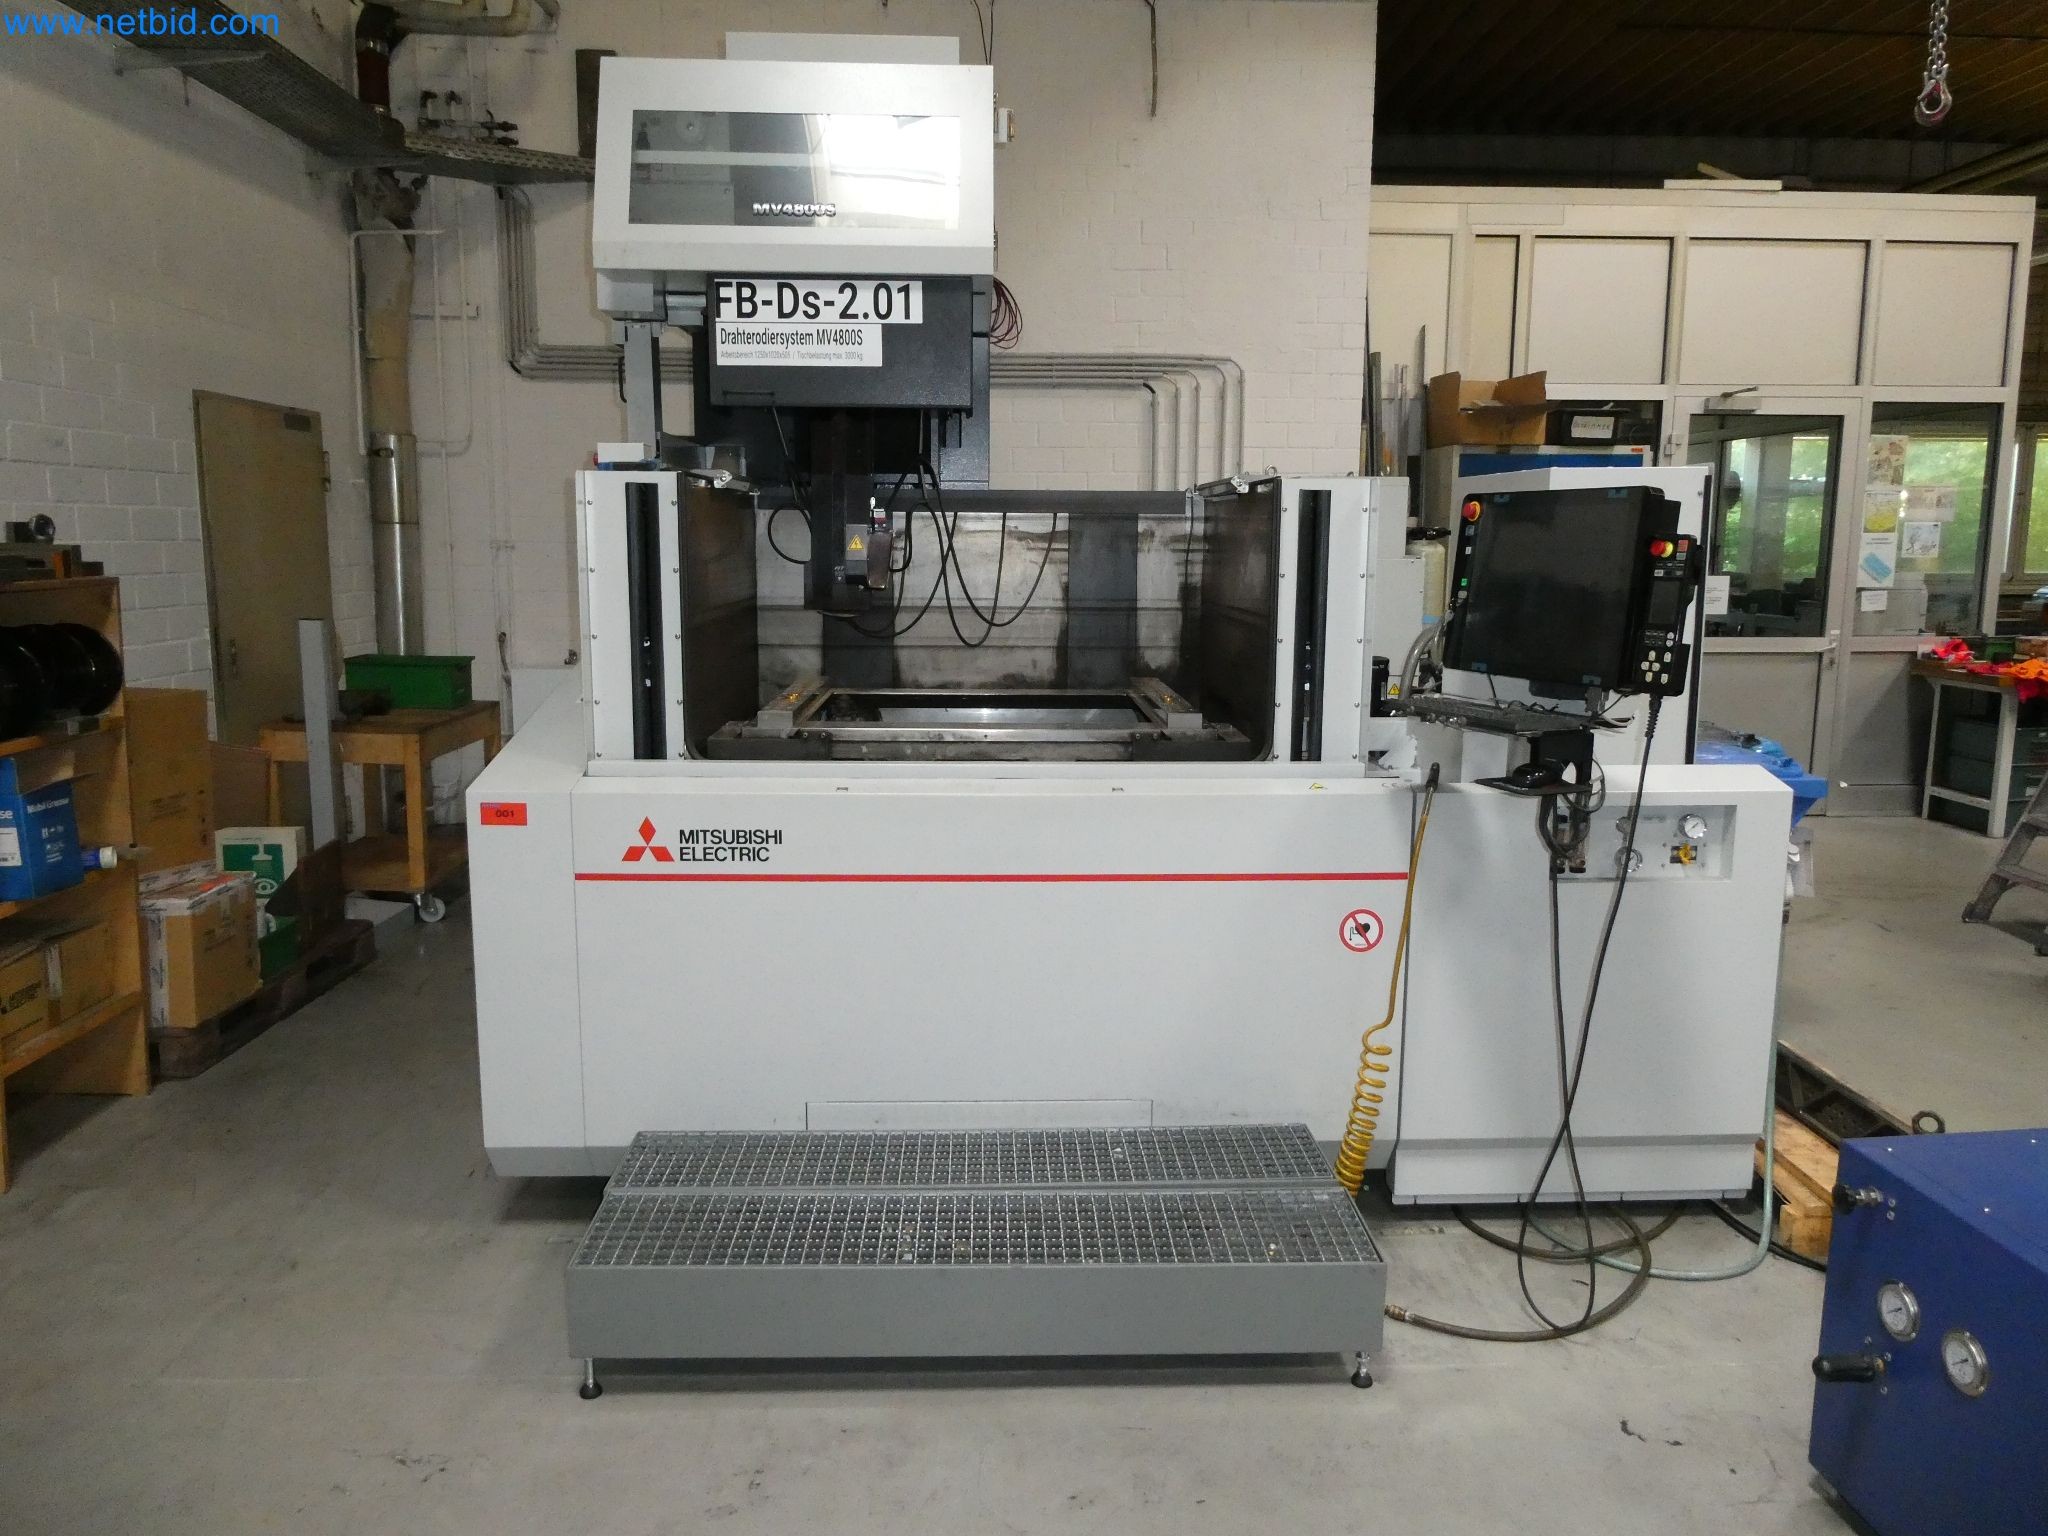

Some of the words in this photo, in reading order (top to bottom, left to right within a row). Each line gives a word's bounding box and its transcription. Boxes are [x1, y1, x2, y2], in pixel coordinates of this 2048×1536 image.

[752, 203, 837, 217] MV4800S
[715, 281, 911, 320] FB-Ds-2.01
[720, 327, 814, 349] Drahterodiersystem
[816, 328, 863, 346] MV4800S
[496, 809, 514, 818] 001
[679, 830, 783, 844] MITSUBISHI
[679, 846, 770, 862] ELECTRIC
